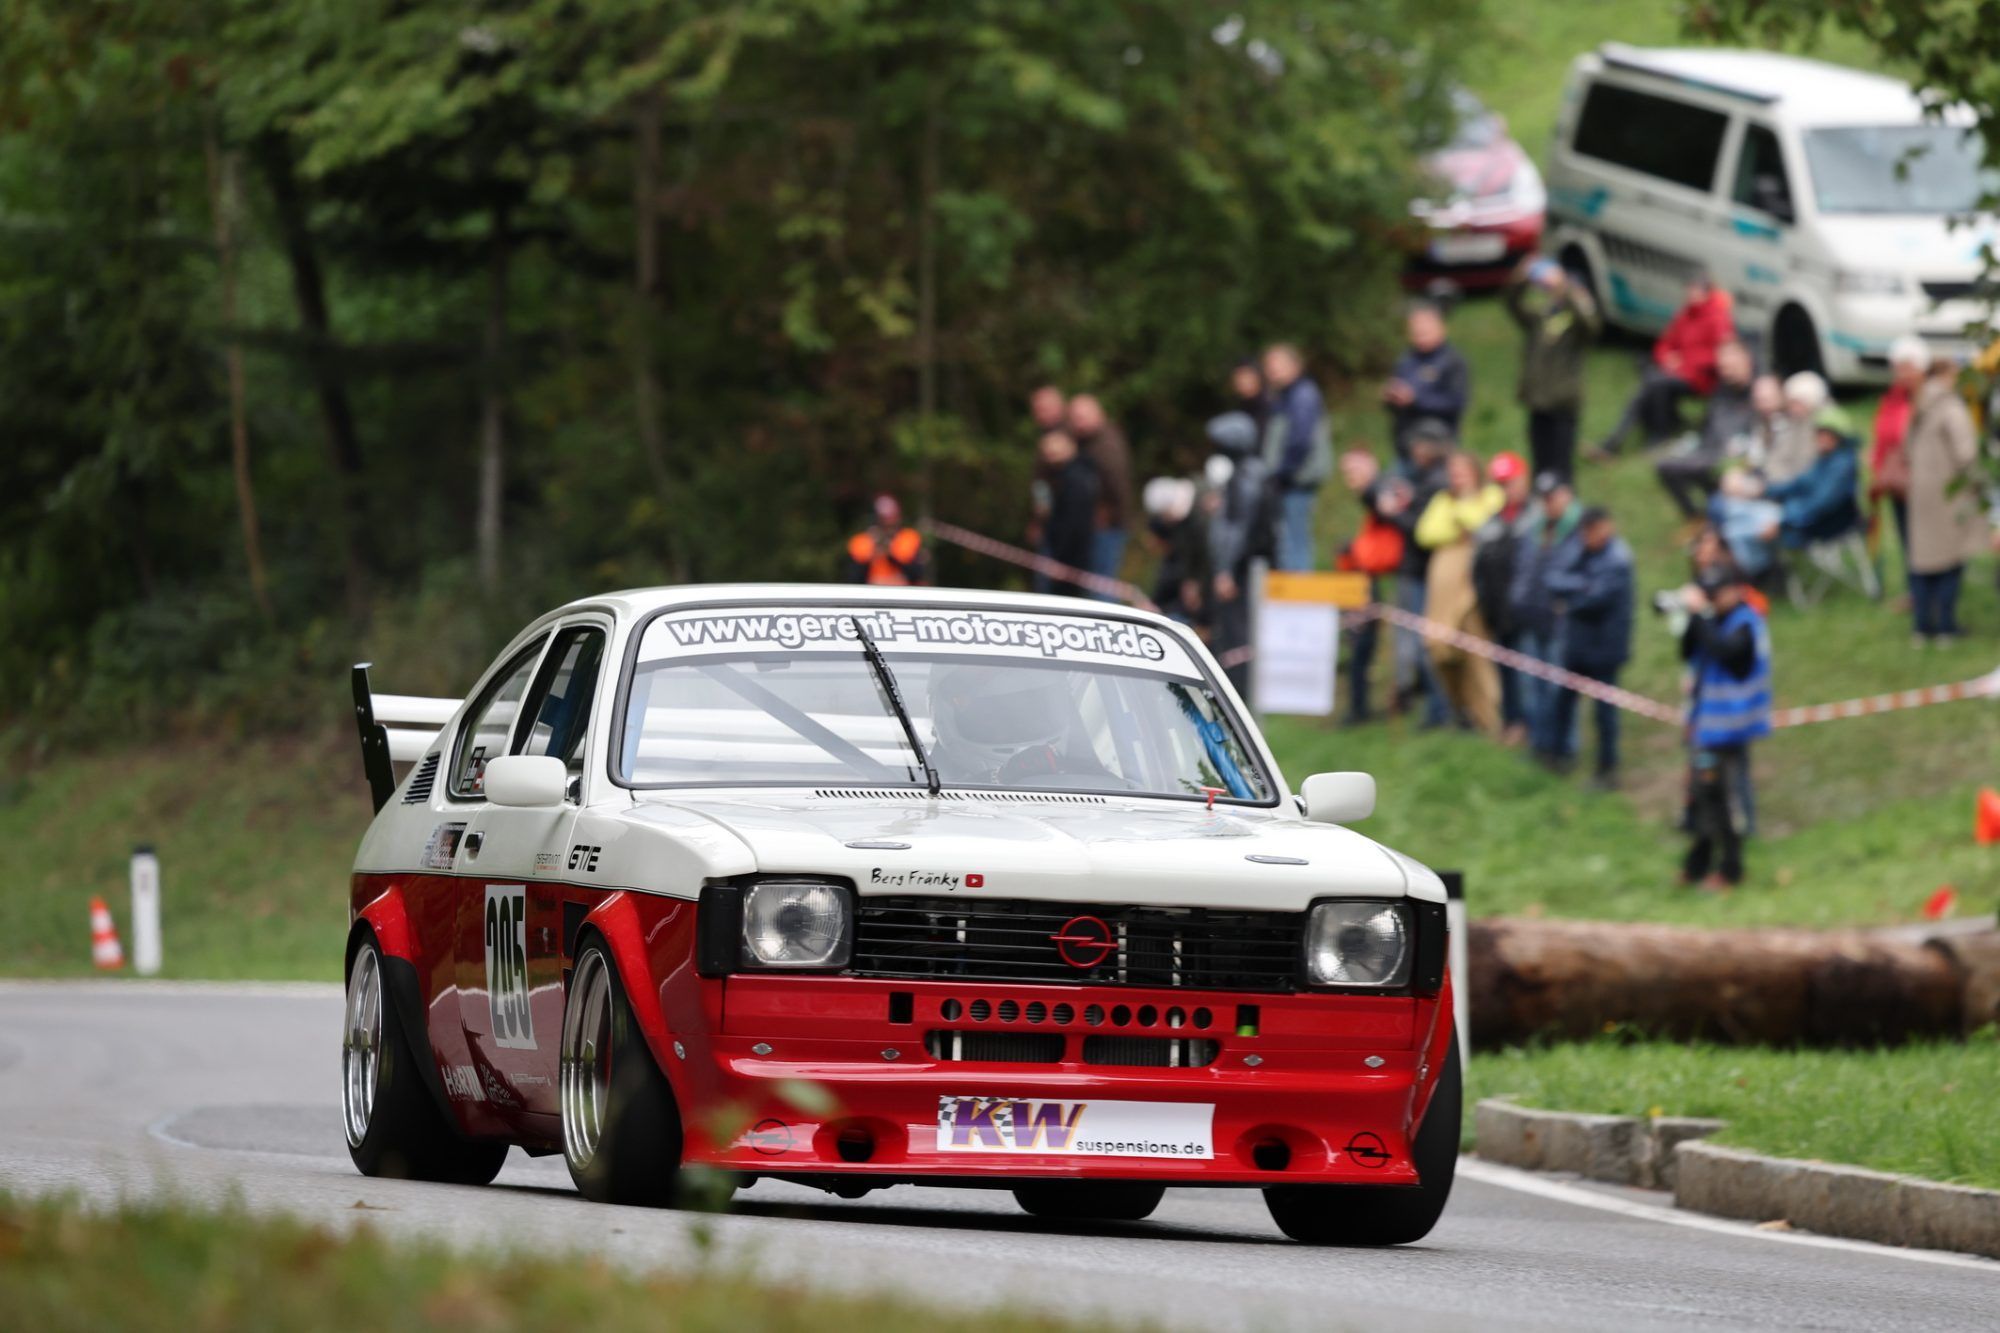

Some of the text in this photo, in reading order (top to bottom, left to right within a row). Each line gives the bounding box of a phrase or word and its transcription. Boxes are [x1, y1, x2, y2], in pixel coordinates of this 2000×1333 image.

[664, 611, 1165, 662] www.gerent-motorsport.de
[871, 867, 904, 886] Berg
[486, 895, 531, 1040] 205
[441, 1065, 473, 1096] H&R
[950, 1099, 1088, 1151] KW
[1076, 1139, 1205, 1156] suspensions.de
